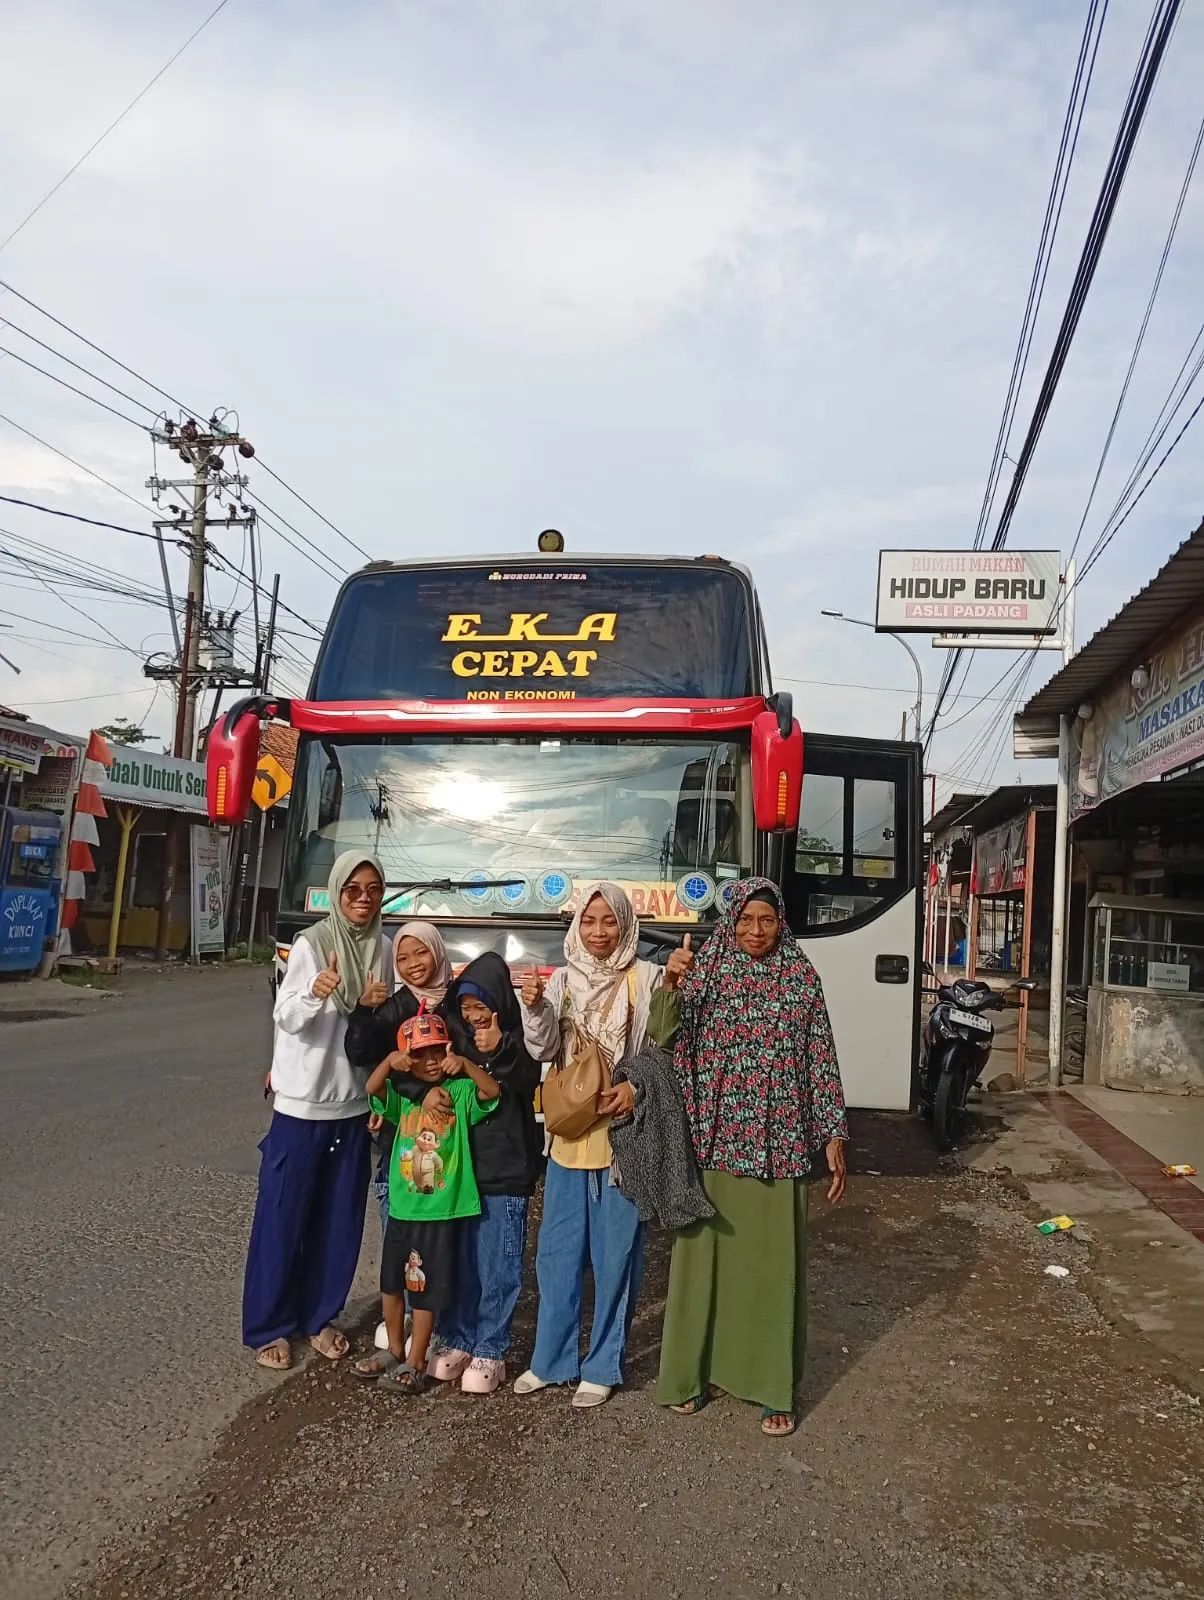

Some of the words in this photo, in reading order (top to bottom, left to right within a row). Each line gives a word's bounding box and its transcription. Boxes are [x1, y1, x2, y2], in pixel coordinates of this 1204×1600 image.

[911, 557, 965, 572] RUMAH
[969, 557, 1025, 573] MAKAN
[890, 577, 966, 599] HIDUP
[974, 578, 1045, 600] BARU
[911, 604, 949, 617] ASLI
[953, 605, 1021, 618] PADANG
[451, 650, 598, 677] CEPAT
[466, 691, 500, 701] NON
[504, 691, 576, 701] EKONOMI
[143, 764, 183, 793] Untuk
[8, 925, 34, 939] KUNCI
